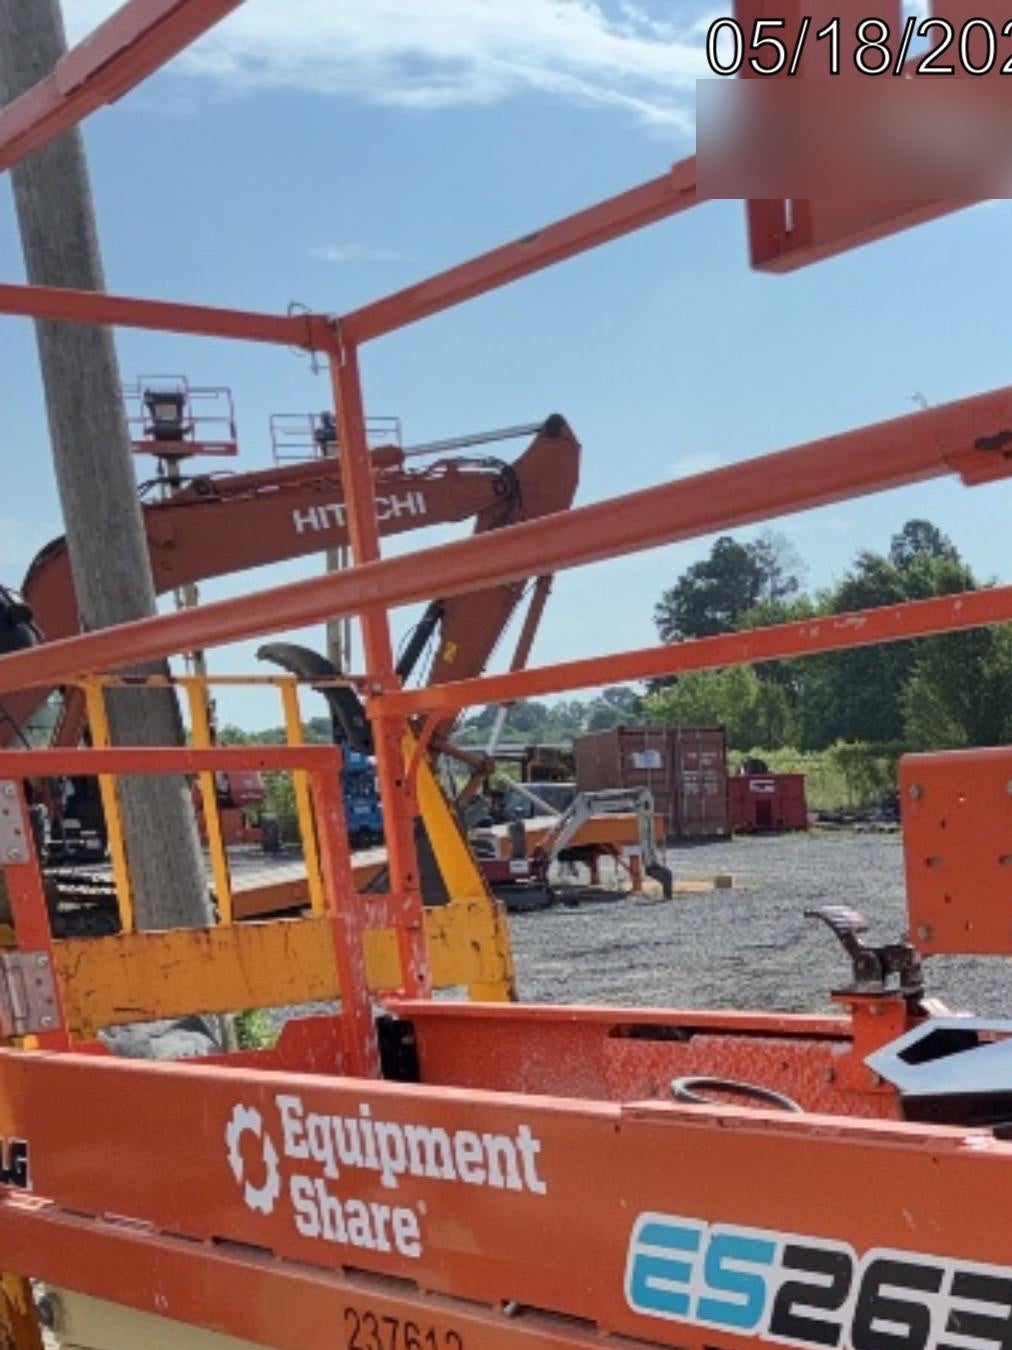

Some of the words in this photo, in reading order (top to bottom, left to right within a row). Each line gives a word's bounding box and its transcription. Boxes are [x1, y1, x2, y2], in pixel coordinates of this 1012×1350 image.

[293, 491, 427, 534] HITCHI
[276, 1094, 547, 1194] Equipment
[288, 1175, 423, 1258] Share
